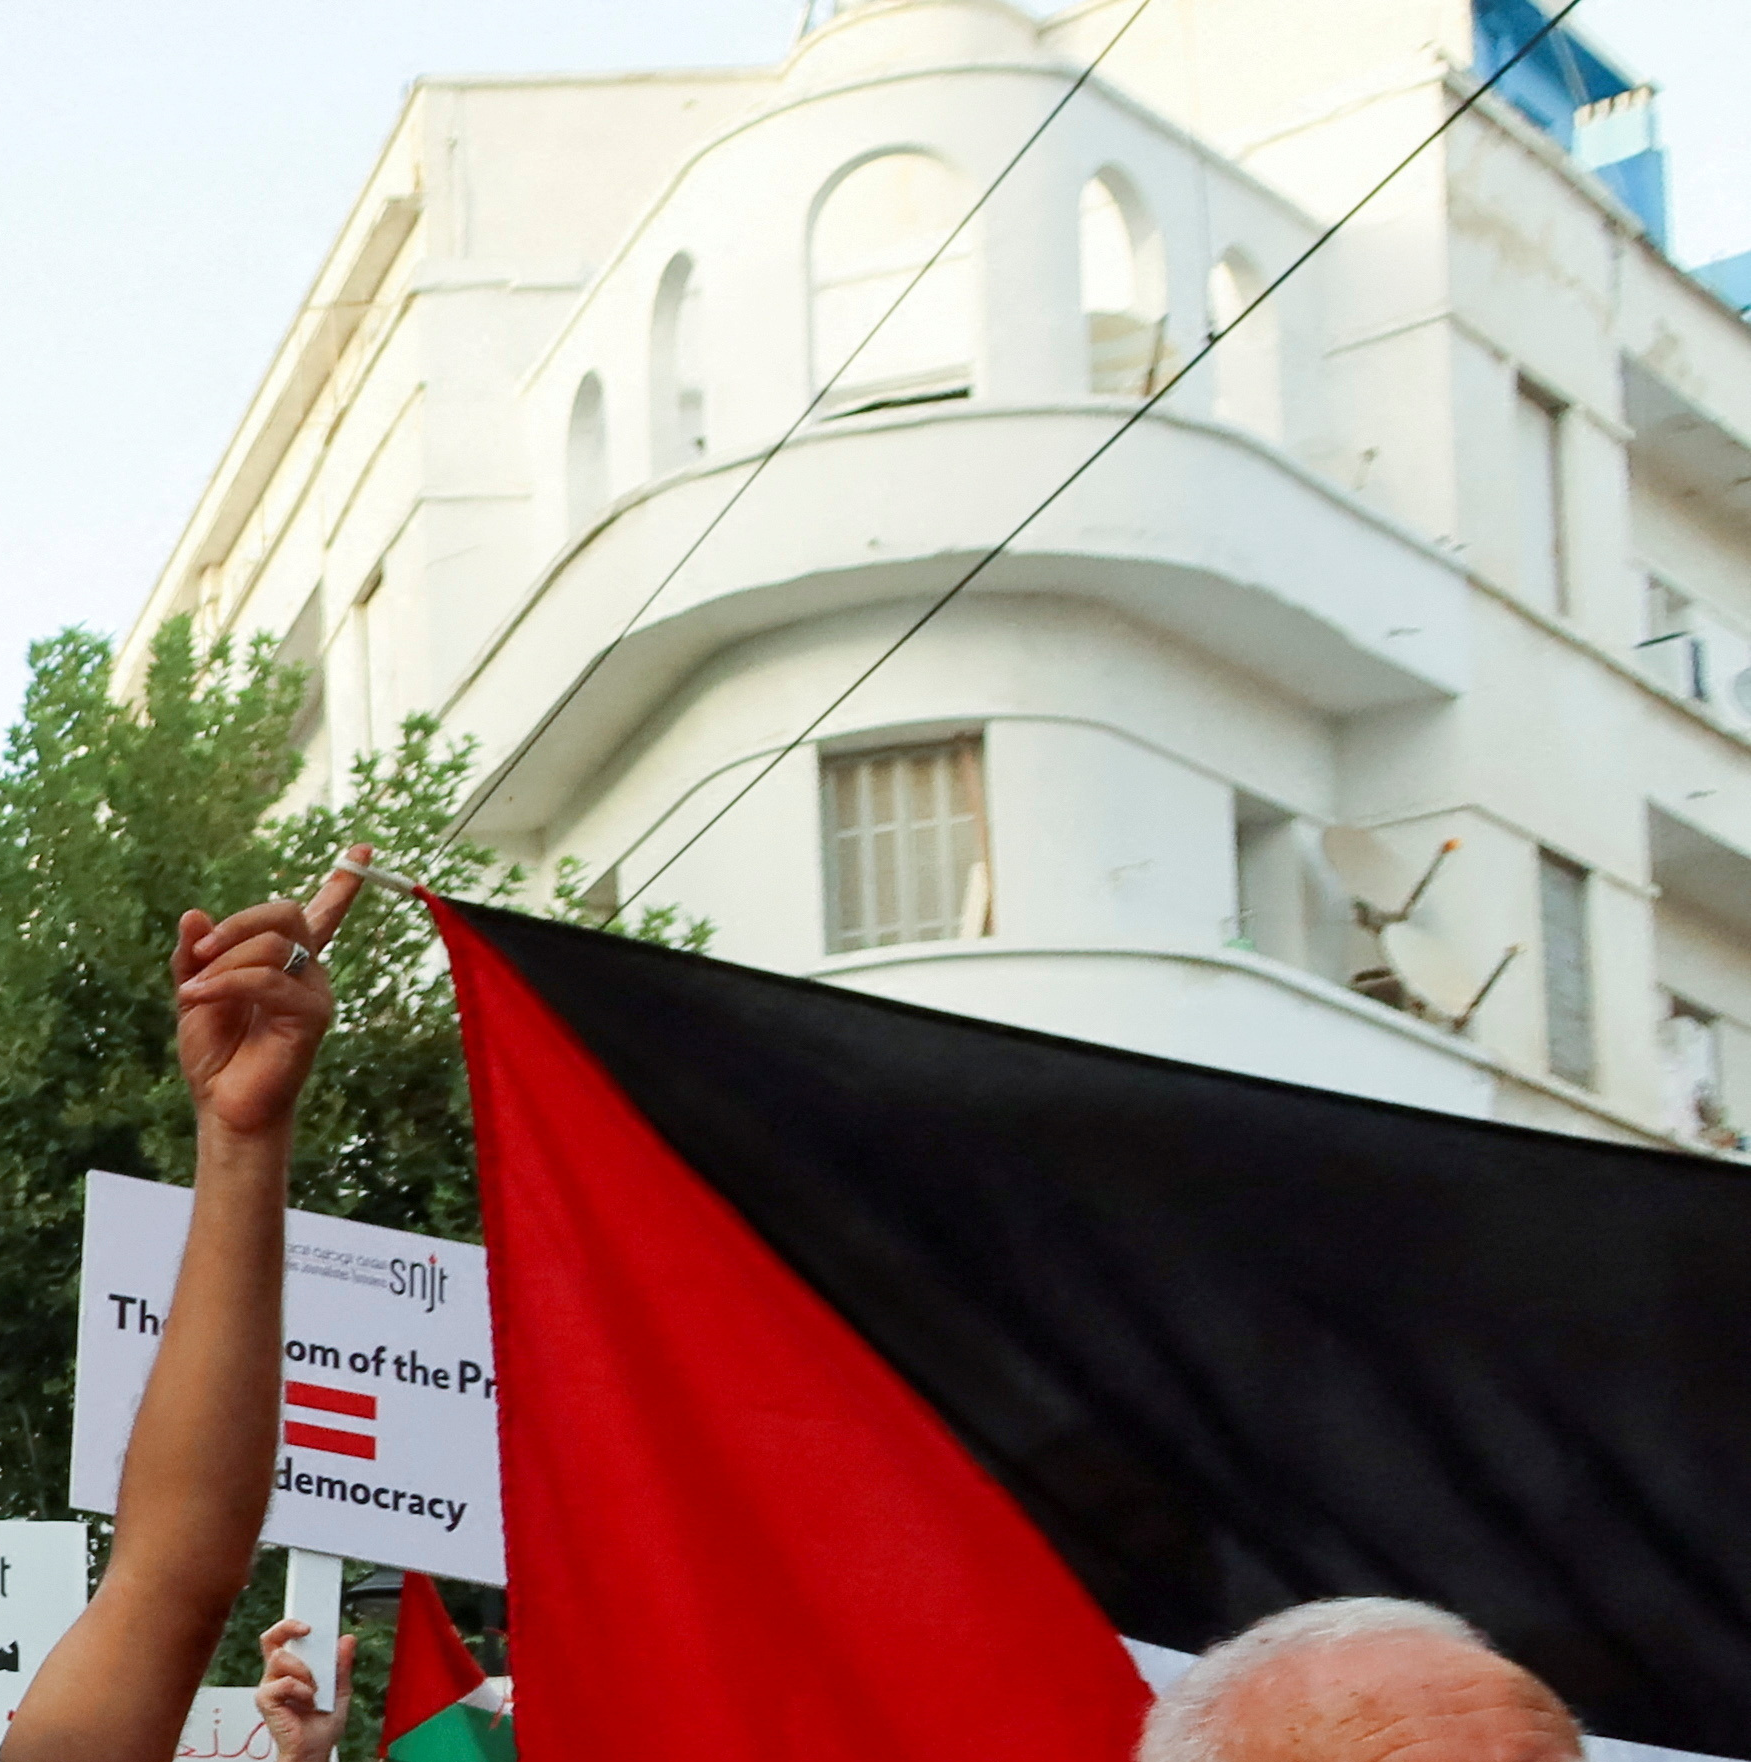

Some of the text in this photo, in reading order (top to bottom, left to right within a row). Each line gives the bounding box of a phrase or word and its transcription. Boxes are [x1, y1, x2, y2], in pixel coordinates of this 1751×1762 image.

[389, 1250, 449, 1315] snjt
[108, 1293, 168, 1336] Th
[348, 1345, 388, 1378] of
[392, 1349, 451, 1390] the
[458, 1359, 498, 1400] Pr
[274, 1456, 468, 1533] democracy
